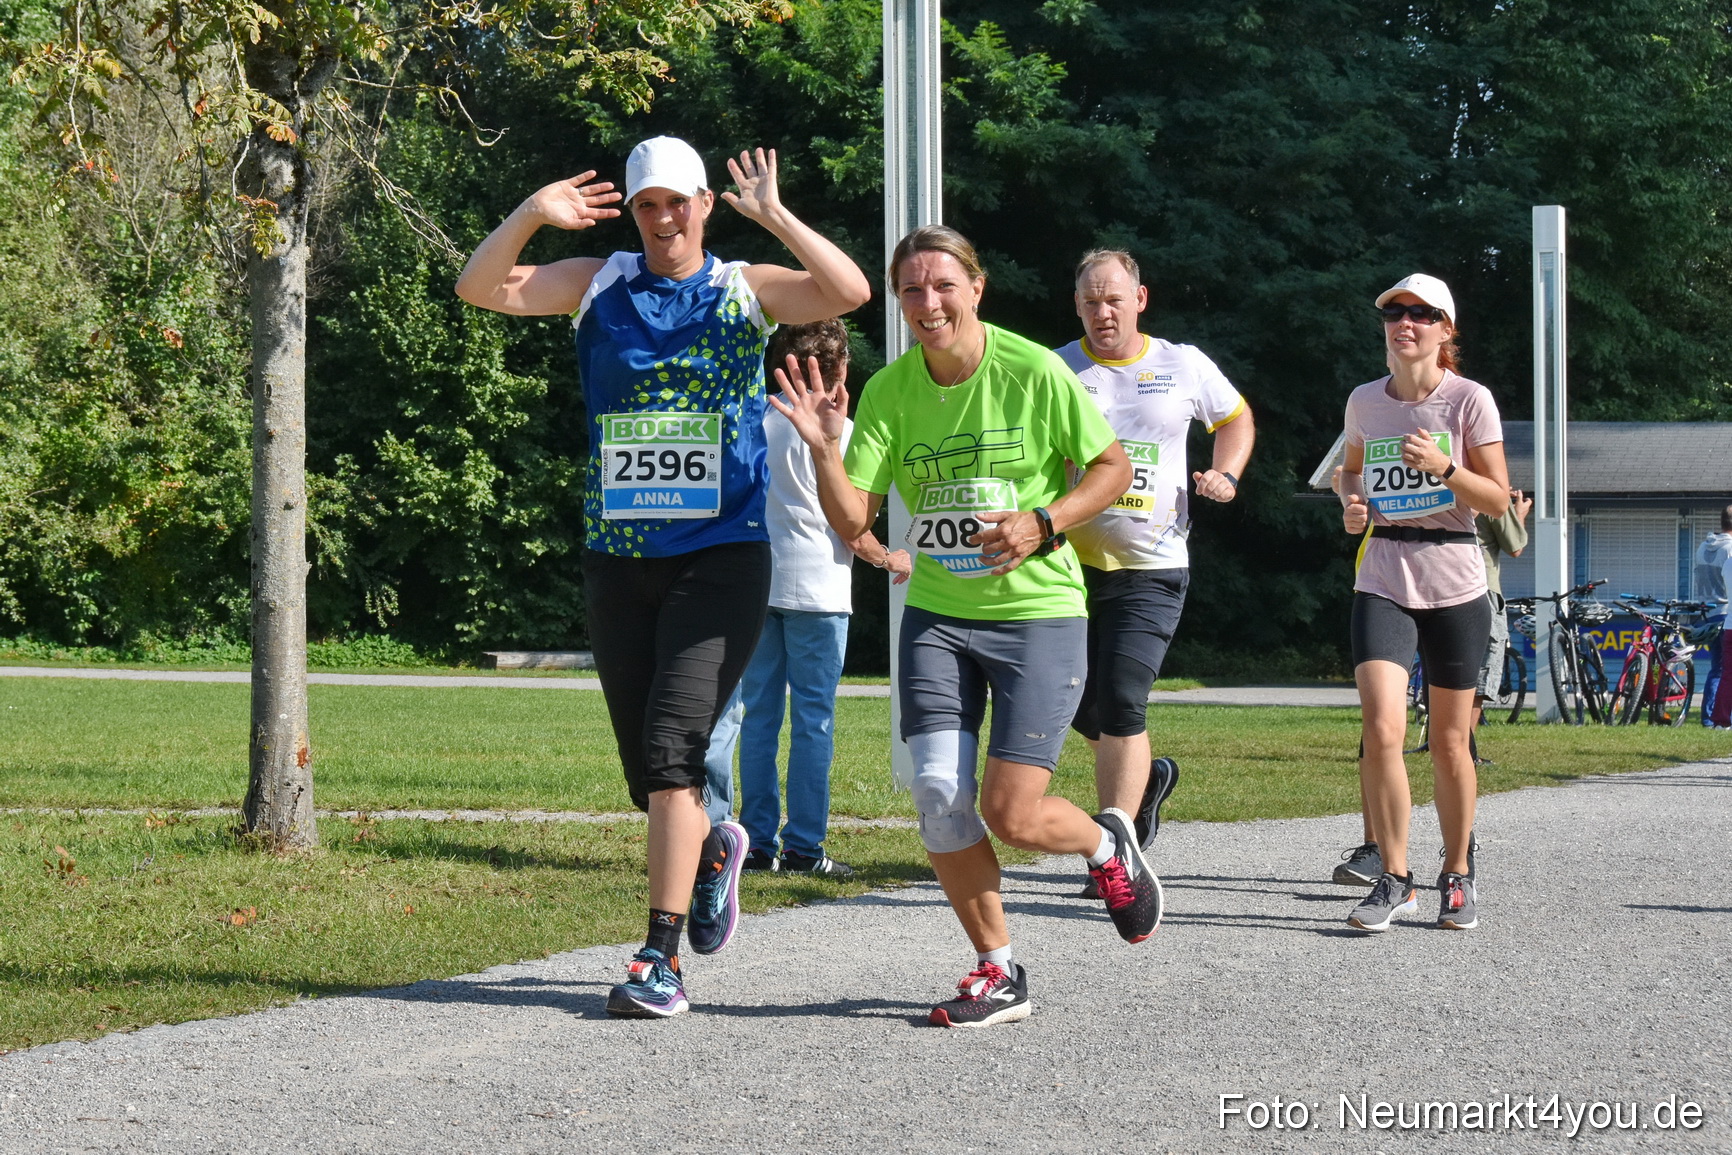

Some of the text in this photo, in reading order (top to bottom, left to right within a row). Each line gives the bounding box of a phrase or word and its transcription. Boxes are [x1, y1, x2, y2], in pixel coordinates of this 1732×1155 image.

[1137, 373, 1154, 382] 20
[612, 417, 710, 441] BOCK
[615, 450, 706, 482] 2596
[632, 492, 684, 506] ANNA
[926, 483, 1003, 510] BOCK
[1378, 495, 1440, 511] MELANIE
[917, 518, 981, 550] 208
